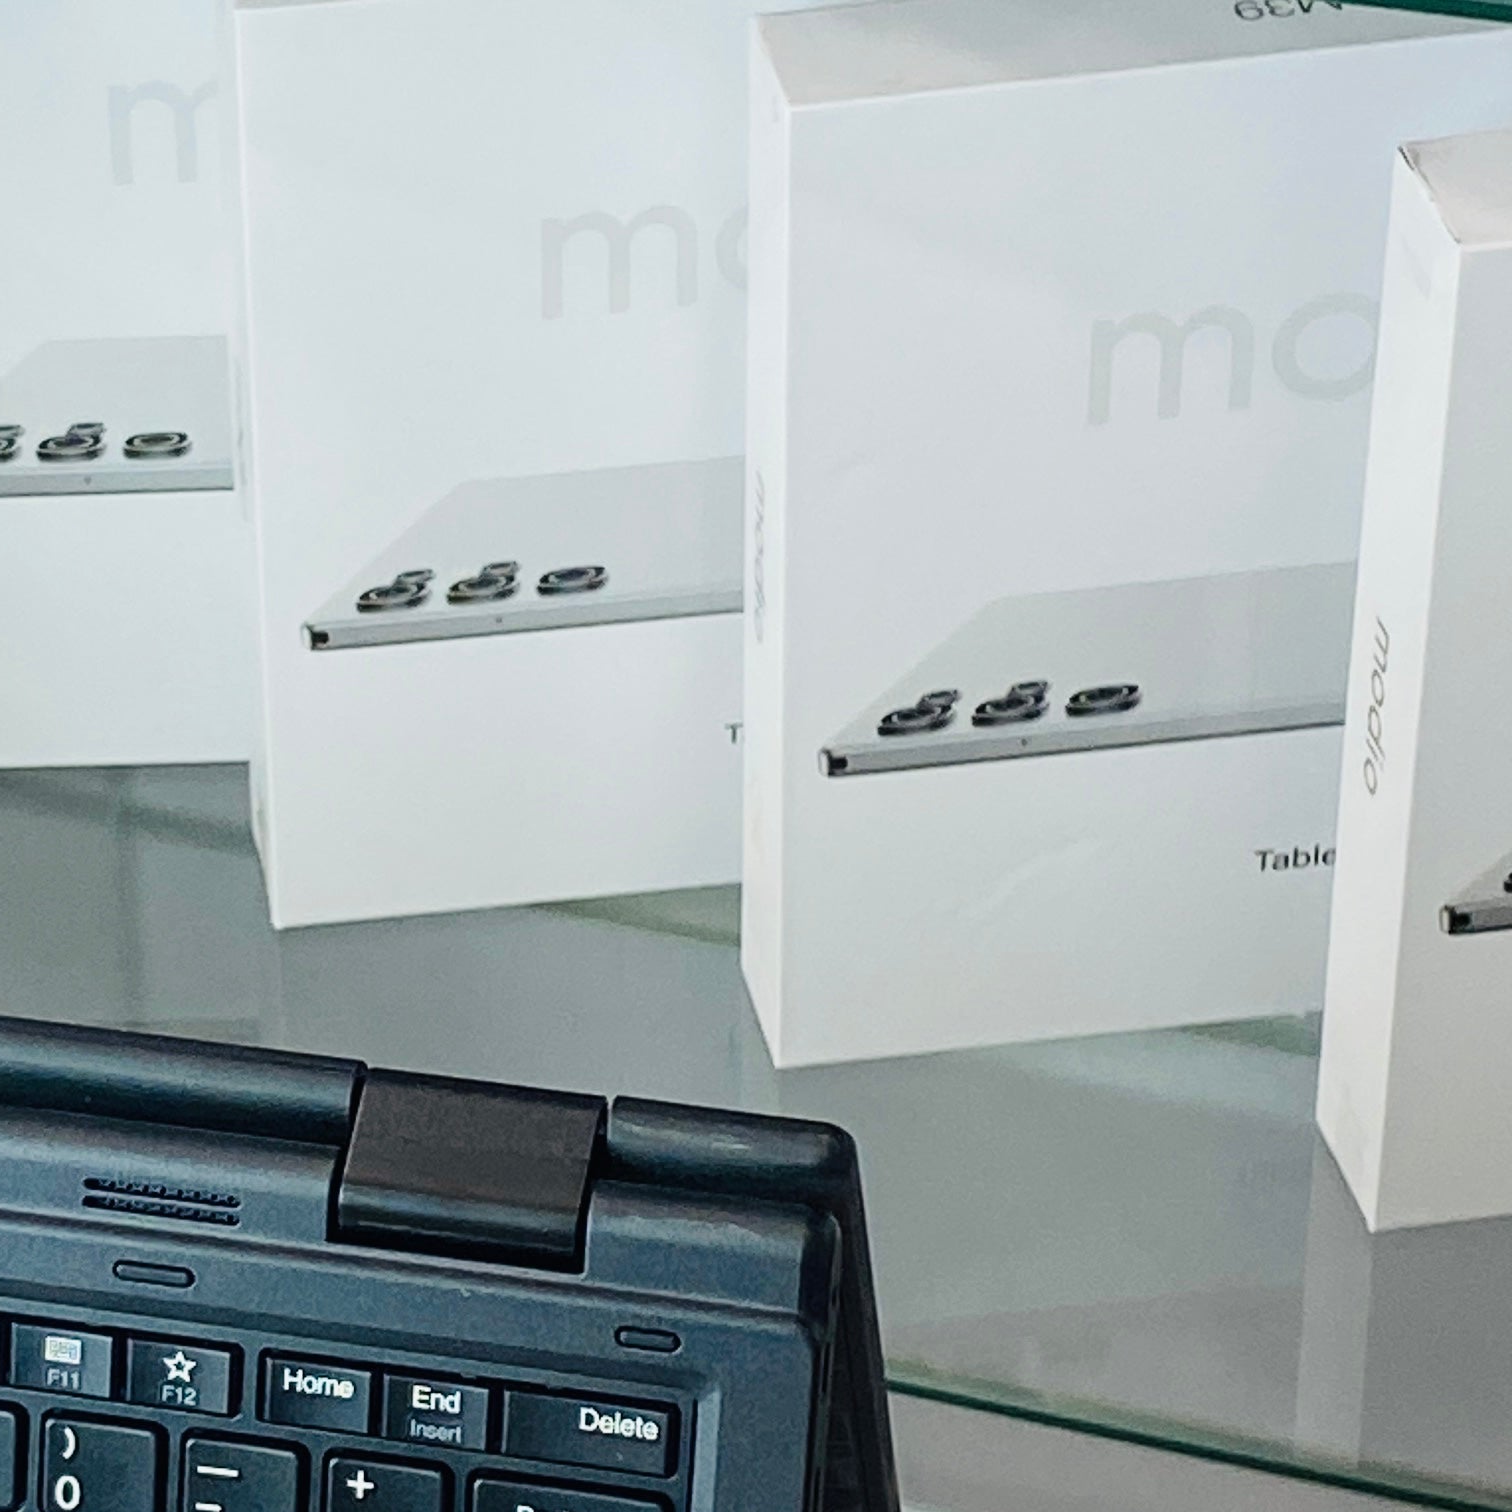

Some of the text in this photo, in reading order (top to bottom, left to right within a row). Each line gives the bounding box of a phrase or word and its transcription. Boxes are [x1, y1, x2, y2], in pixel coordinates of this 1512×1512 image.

[1362, 615, 1391, 796] modio
[47, 1368, 80, 1390] F11
[283, 1368, 355, 1399] Home
[161, 1384, 197, 1406] F12
[412, 1384, 464, 1414] End
[410, 1418, 462, 1444] Insert
[578, 1406, 659, 1440] Delete
[62, 1426, 76, 1460] )
[54, 1475, 81, 1511] 0
[346, 1470, 375, 1499] +
